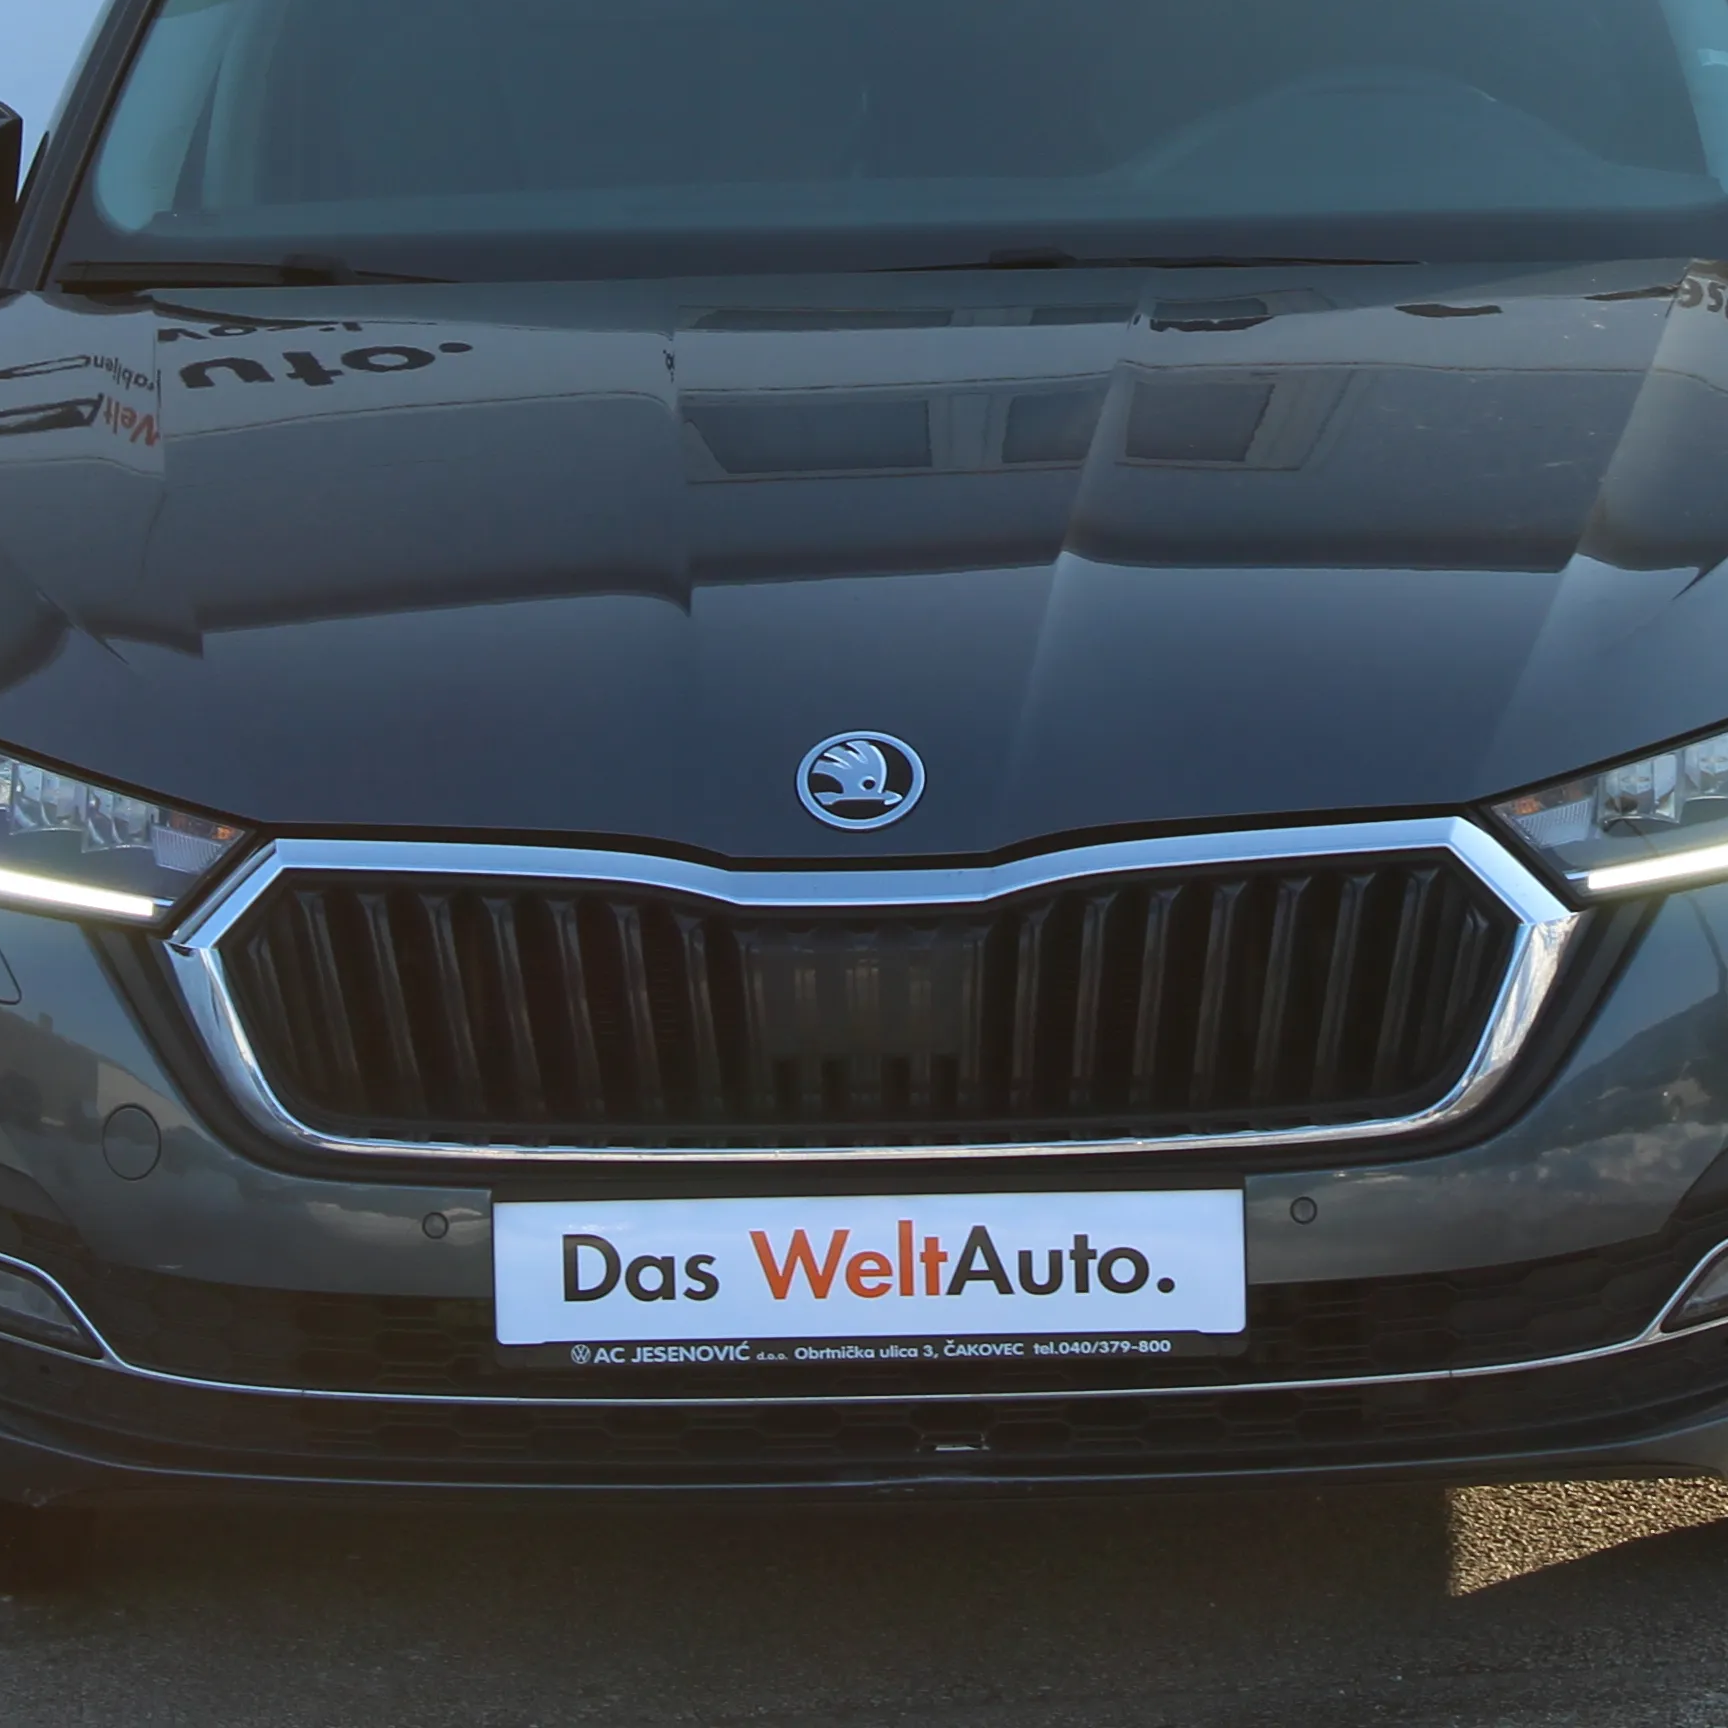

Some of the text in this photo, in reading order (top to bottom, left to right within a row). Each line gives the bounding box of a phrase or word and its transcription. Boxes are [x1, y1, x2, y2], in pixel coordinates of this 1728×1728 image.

[562, 1219, 1176, 1303] Das WeltAuto.
[593, 1346, 626, 1363] AC
[630, 1340, 751, 1363] JESENOVIĆ
[756, 1351, 789, 1361] d.o.o.
[793, 1345, 876, 1360] Obrtnička
[879, 1344, 919, 1359] ulica
[922, 1344, 939, 1360] 3,
[943, 1339, 1025, 1358] ČAKOVEC
[1033, 1339, 1172, 1356] tel.040/379-800
